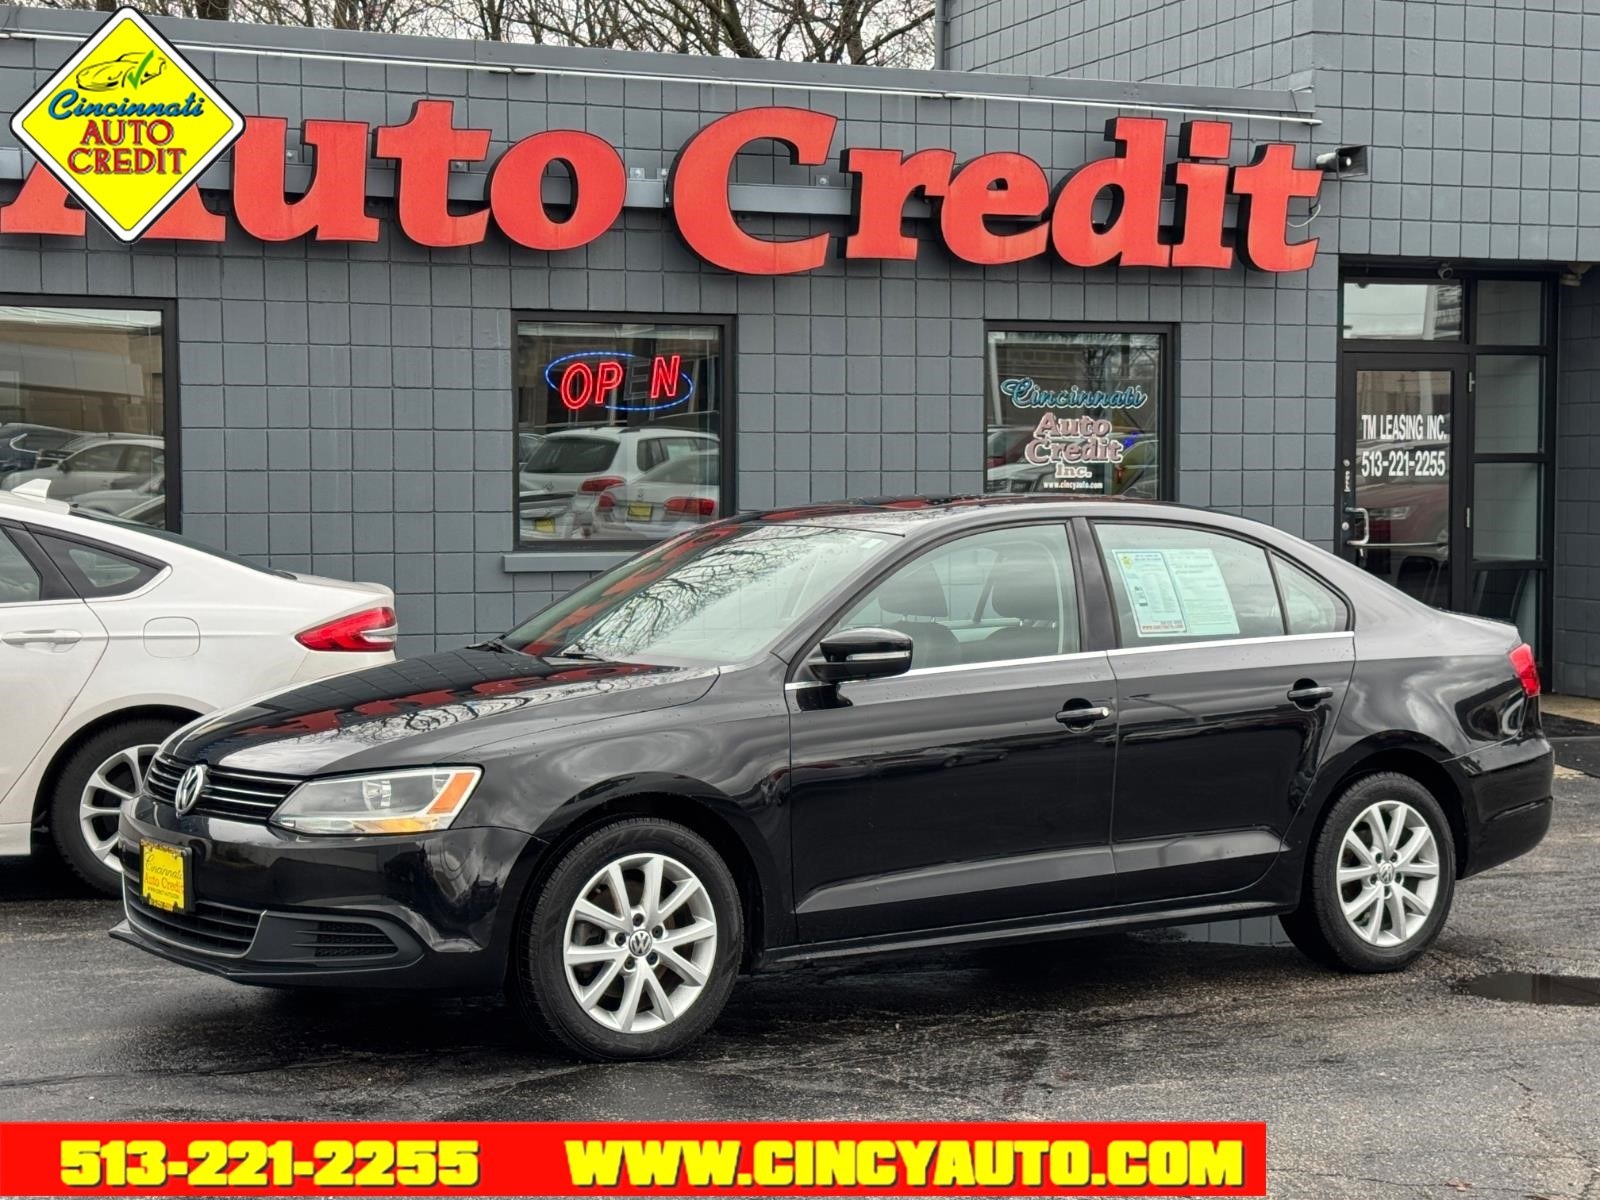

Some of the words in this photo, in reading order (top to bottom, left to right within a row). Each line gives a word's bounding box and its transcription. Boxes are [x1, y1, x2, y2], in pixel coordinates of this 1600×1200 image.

[671, 106, 1322, 275] Credit
[560, 354, 681, 410] OPEN
[1000, 377, 1148, 408] Cincinnati
[1033, 412, 1112, 438] Auto
[1361, 414, 1377, 440] TM
[1380, 414, 1424, 440] LEASING
[1427, 414, 1447, 440] INC.
[1025, 438, 1124, 465] Credit
[1361, 450, 1446, 477] 513-221-2255
[1055, 463, 1093, 478] Inc.
[1043, 481, 1103, 490] www.cincyauto.com
